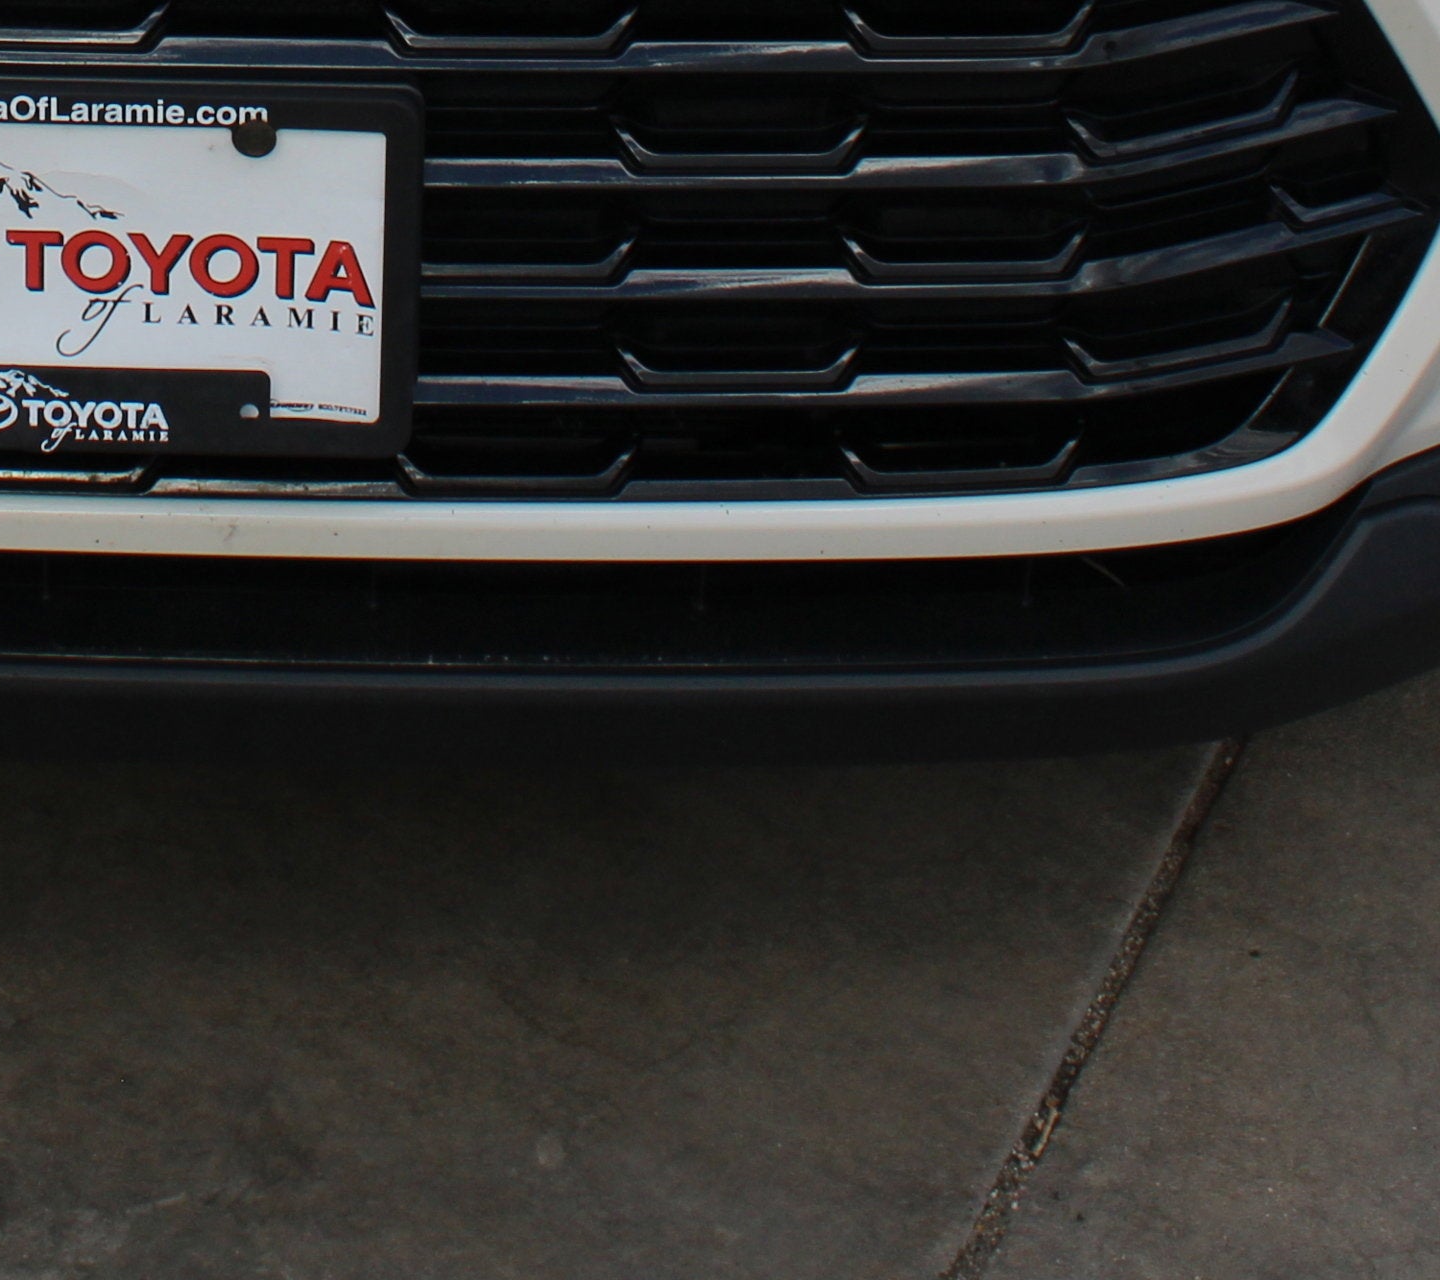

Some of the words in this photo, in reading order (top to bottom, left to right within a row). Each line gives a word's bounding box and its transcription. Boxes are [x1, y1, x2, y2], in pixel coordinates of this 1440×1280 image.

[6, 229, 376, 309] TOYOTA
[56, 283, 144, 357] of
[142, 302, 375, 337] LARAMIE
[22, 398, 170, 430] TOYOTA
[41, 422, 77, 453] of
[75, 429, 170, 442] LARAMIE
